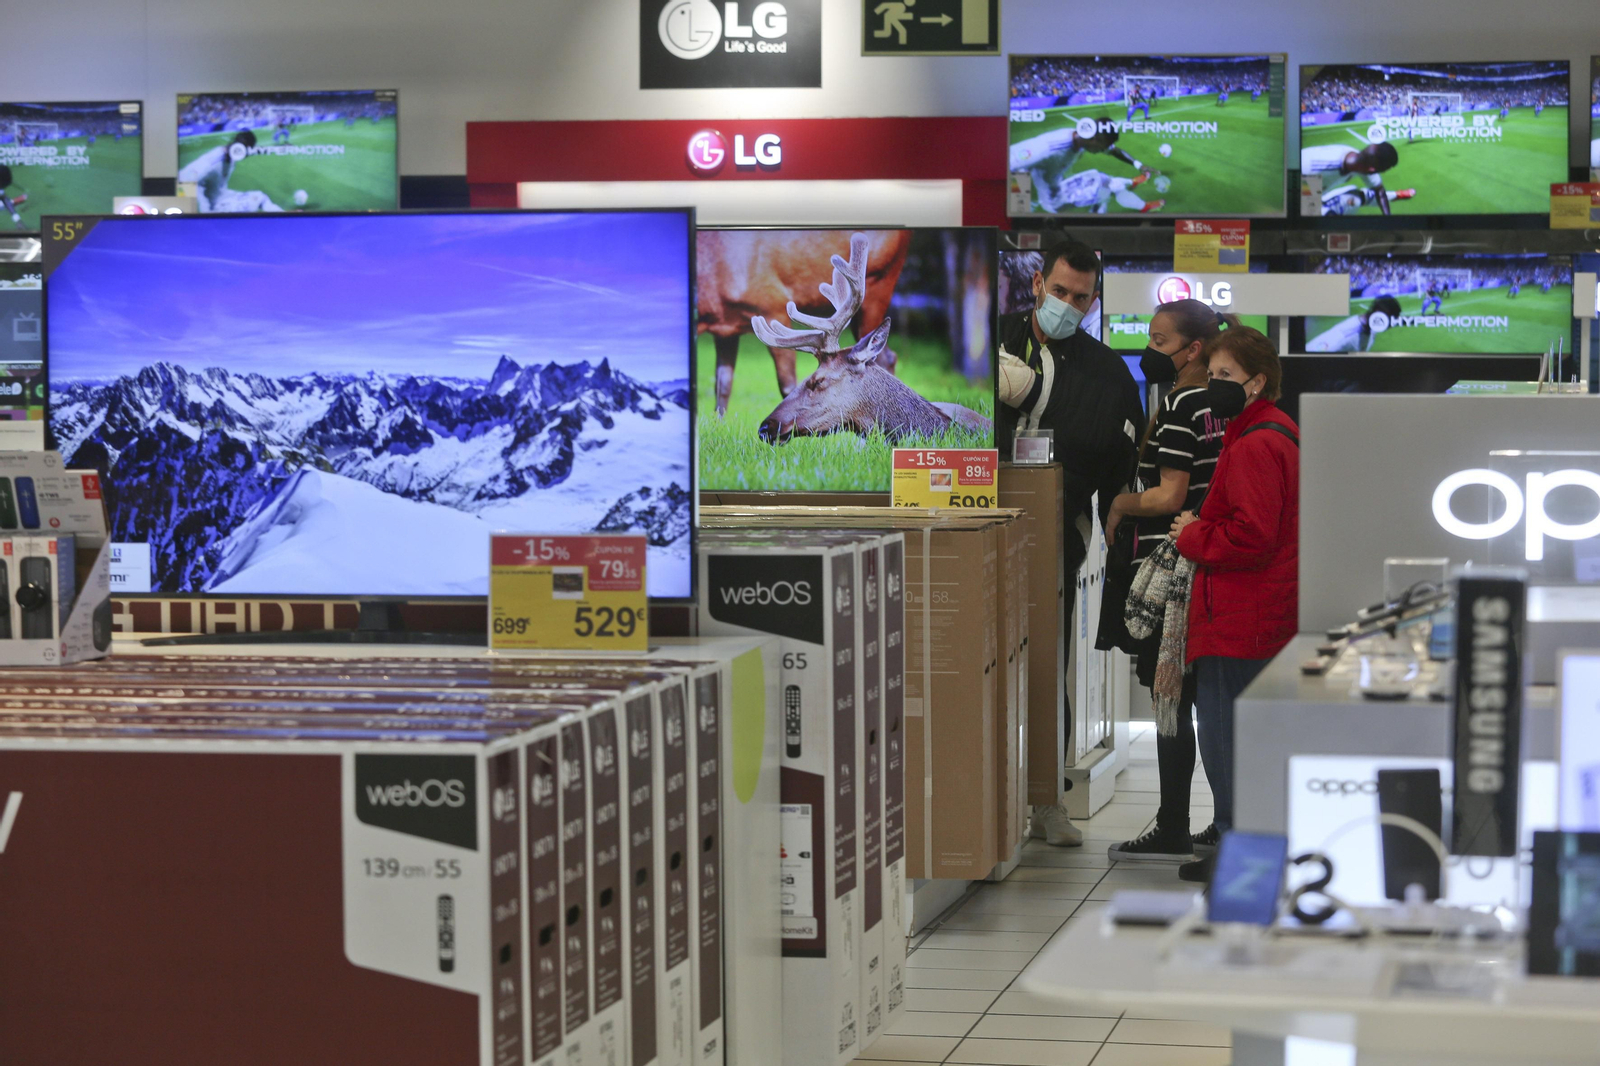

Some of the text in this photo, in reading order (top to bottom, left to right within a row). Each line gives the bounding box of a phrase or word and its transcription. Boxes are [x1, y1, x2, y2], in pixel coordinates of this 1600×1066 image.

[725, 2, 787, 38] LG
[725, 41, 787, 53] Life's Good
[1010, 110, 1046, 122] RED
[1376, 114, 1497, 127] POWERED BY
[1098, 121, 1218, 133] HYPERMOTION
[1389, 126, 1502, 138] HYPERMOTION
[67, 146, 86, 155] BY
[247, 145, 345, 156] HYPERMOTION
[734, 133, 782, 165] LG
[1196, 281, 1231, 306] LG
[1390, 316, 1508, 328] HYPERMOTION
[908, 452, 946, 466] -15%
[513, 539, 570, 560] -15%
[594, 545, 622, 554] CUPÓN
[721, 581, 811, 605] webOS
[933, 591, 949, 604] 58
[574, 607, 645, 638] 529€
[783, 652, 808, 670] 65
[366, 779, 465, 807] webOS
[1306, 778, 1380, 797] oppo
[364, 858, 400, 878] 139
[436, 859, 462, 878] 55
